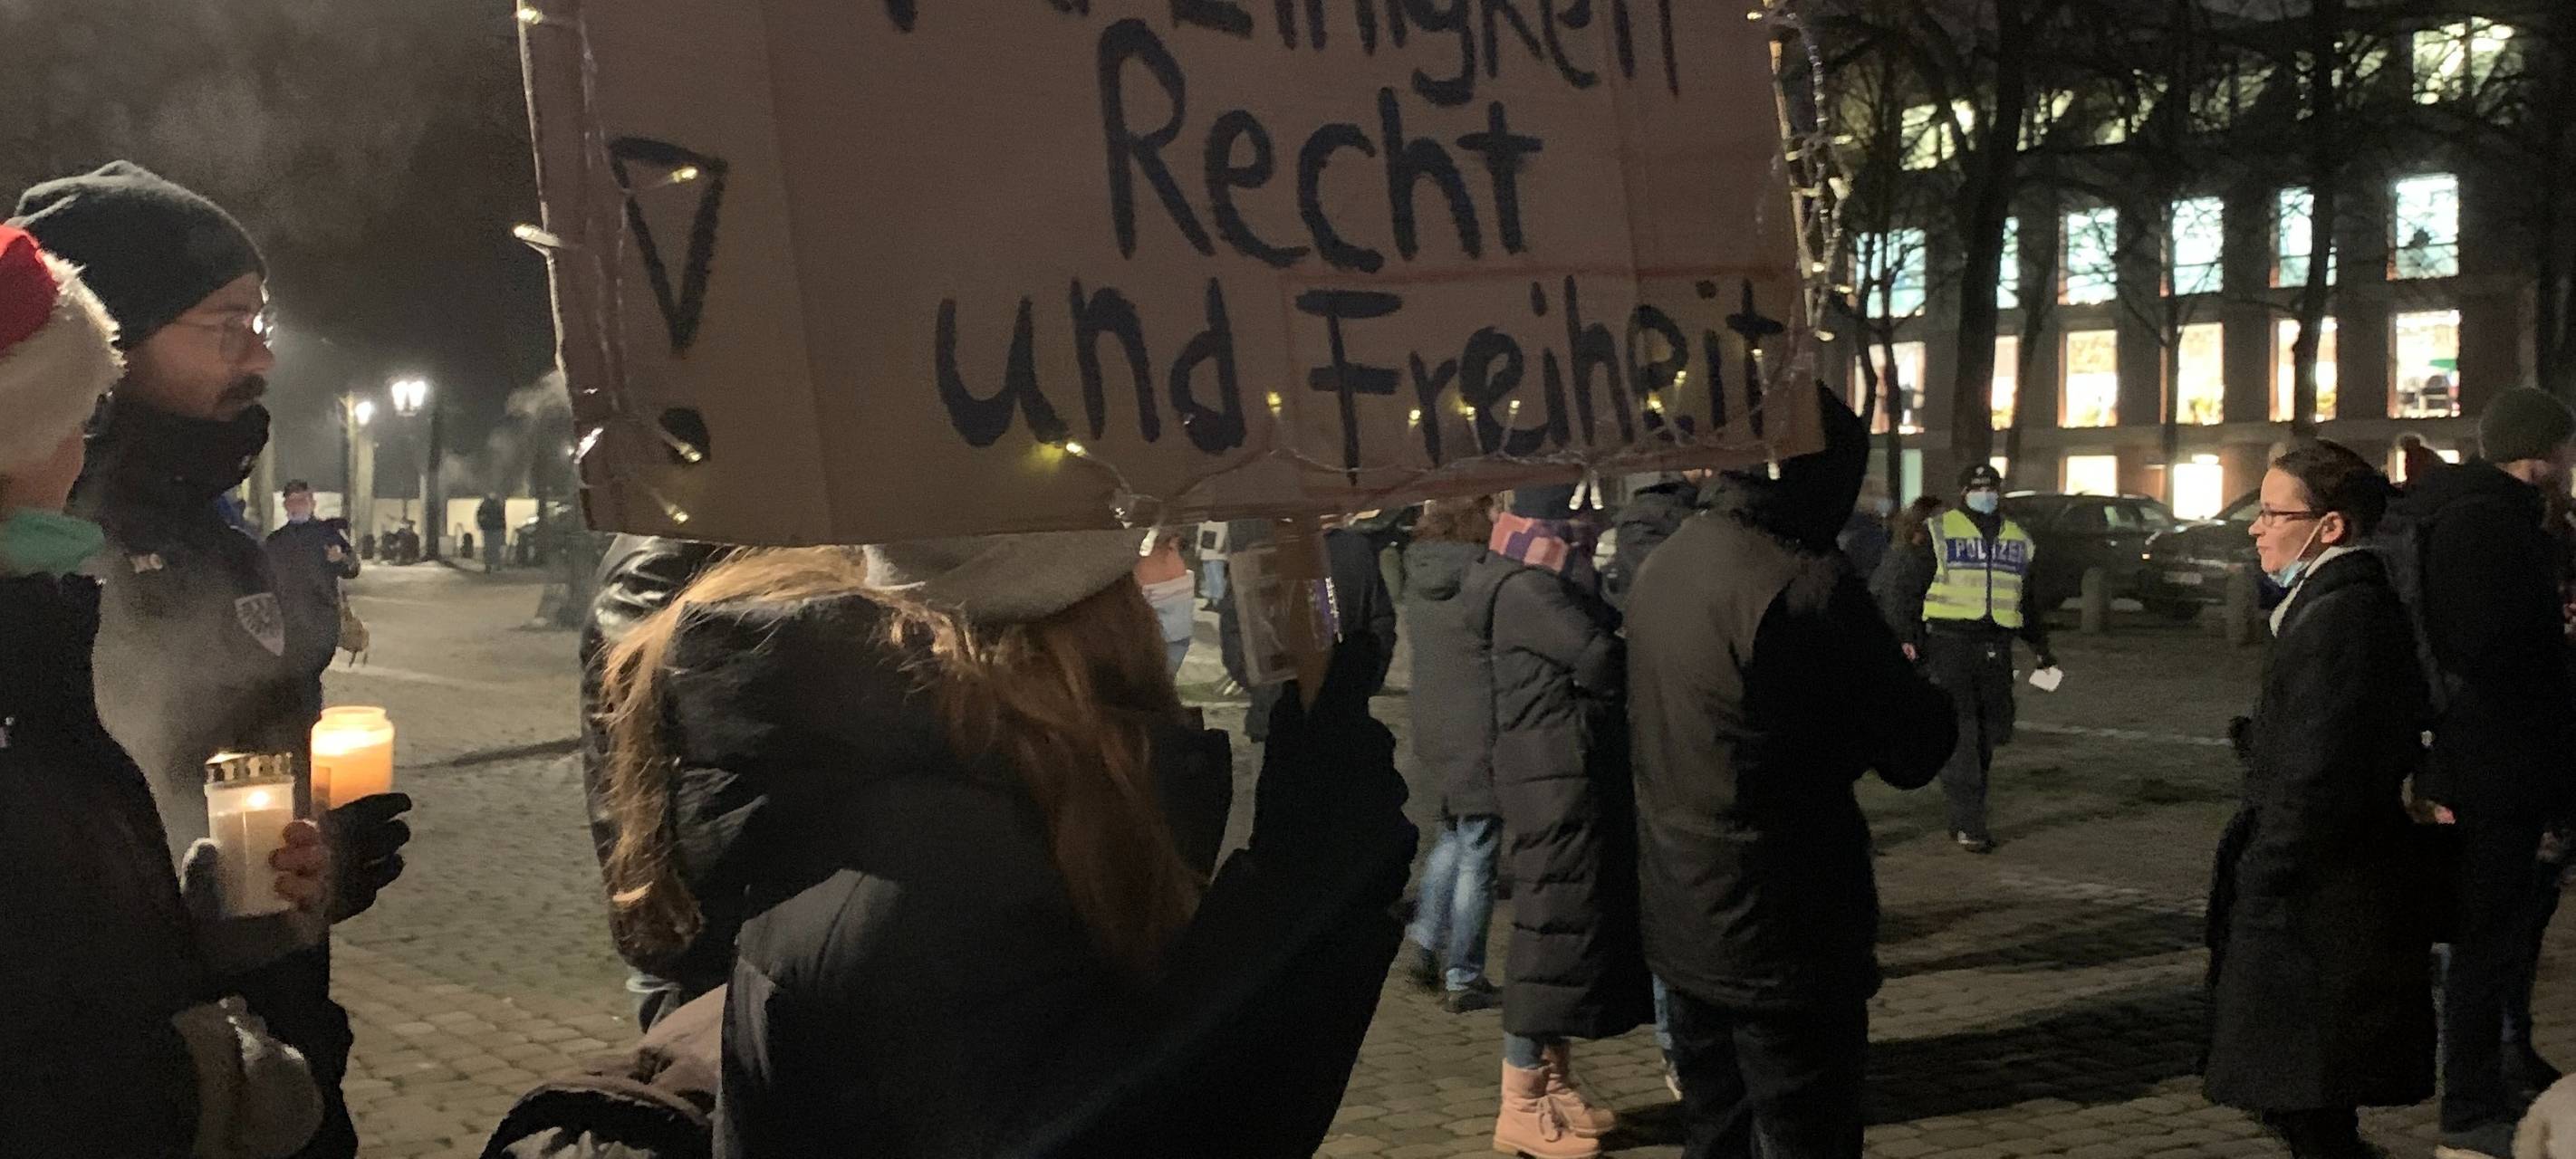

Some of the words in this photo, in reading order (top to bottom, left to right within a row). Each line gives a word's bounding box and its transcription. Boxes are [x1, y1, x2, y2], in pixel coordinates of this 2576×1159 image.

[1097, 18, 1543, 271] Recht
[936, 276, 1246, 453] und
[1296, 275, 1784, 486] Freiheit
